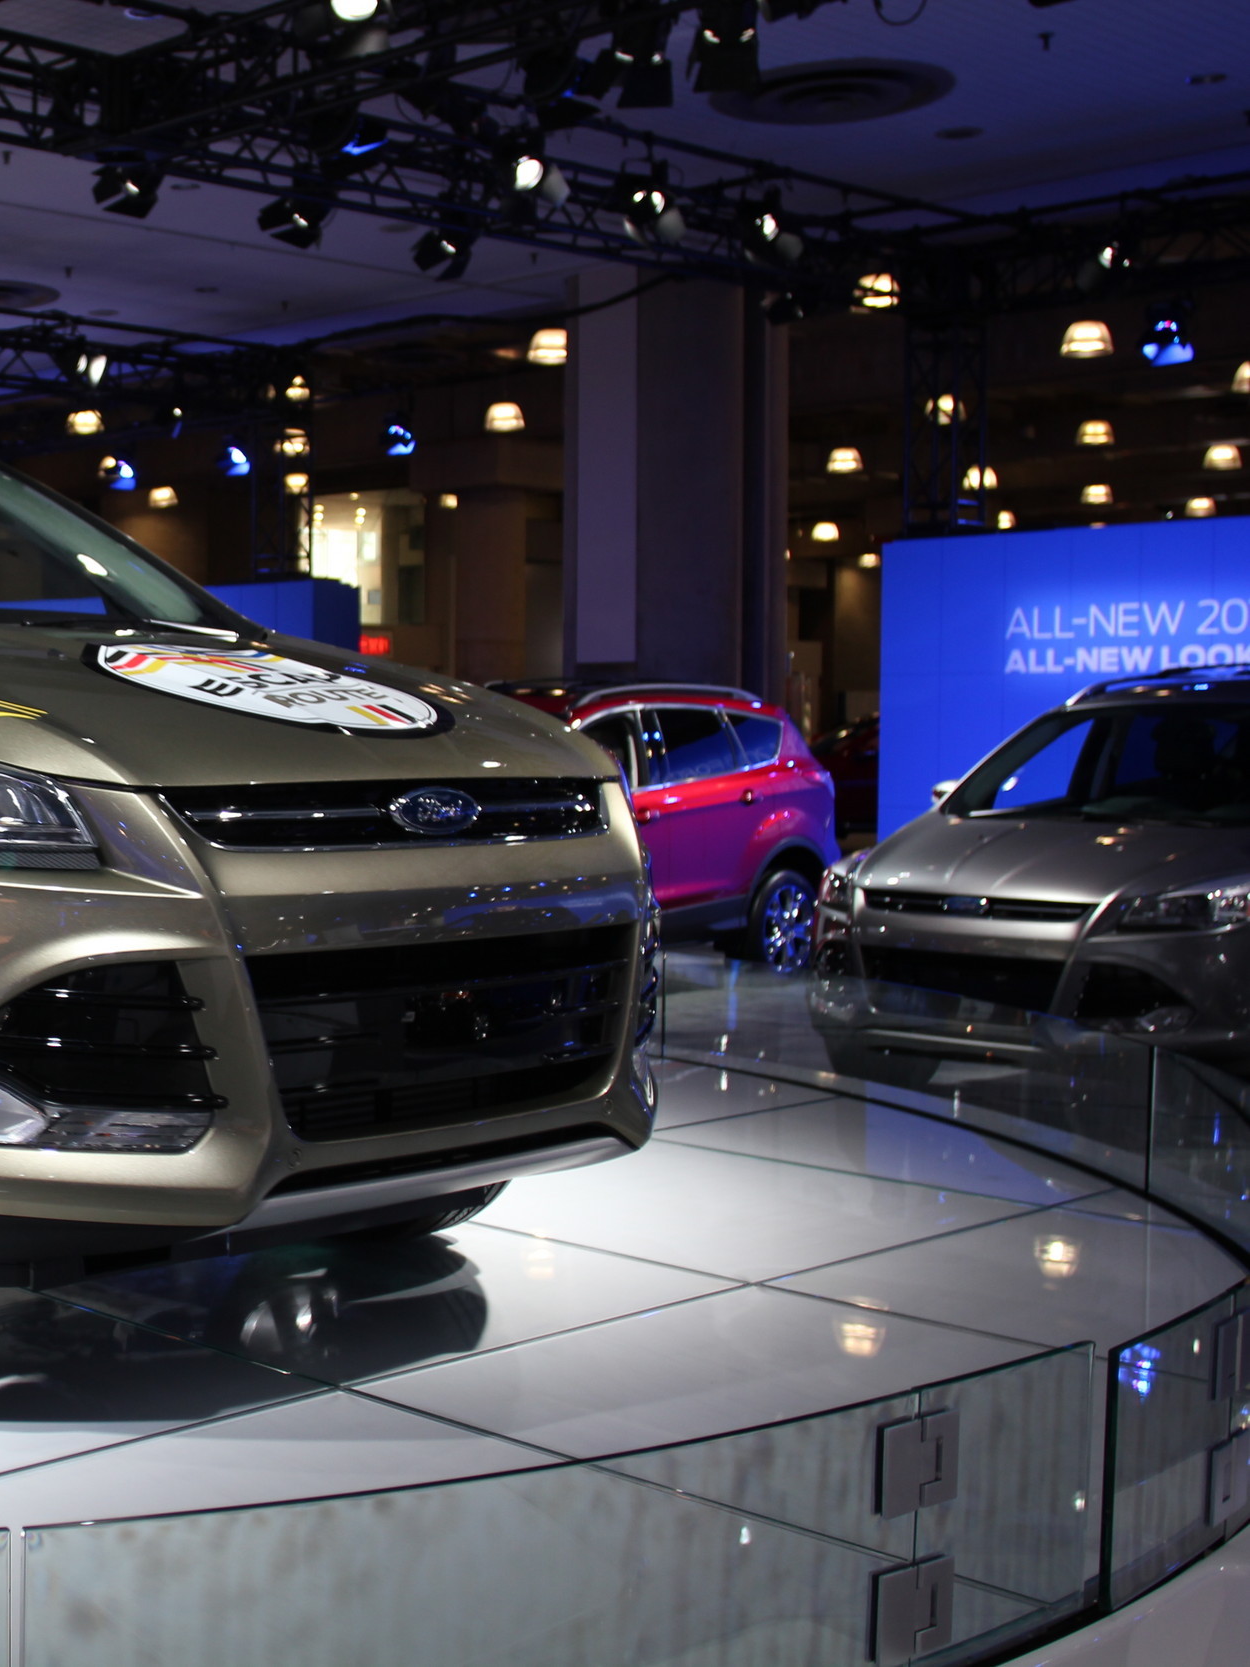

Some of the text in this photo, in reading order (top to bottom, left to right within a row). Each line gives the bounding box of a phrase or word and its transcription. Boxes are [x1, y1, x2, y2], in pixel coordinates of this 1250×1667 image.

[1004, 597, 1250, 640] ALL-NEW 20
[1004, 646, 1153, 675] ALL-NEW
[262, 685, 403, 708] ROUTE
